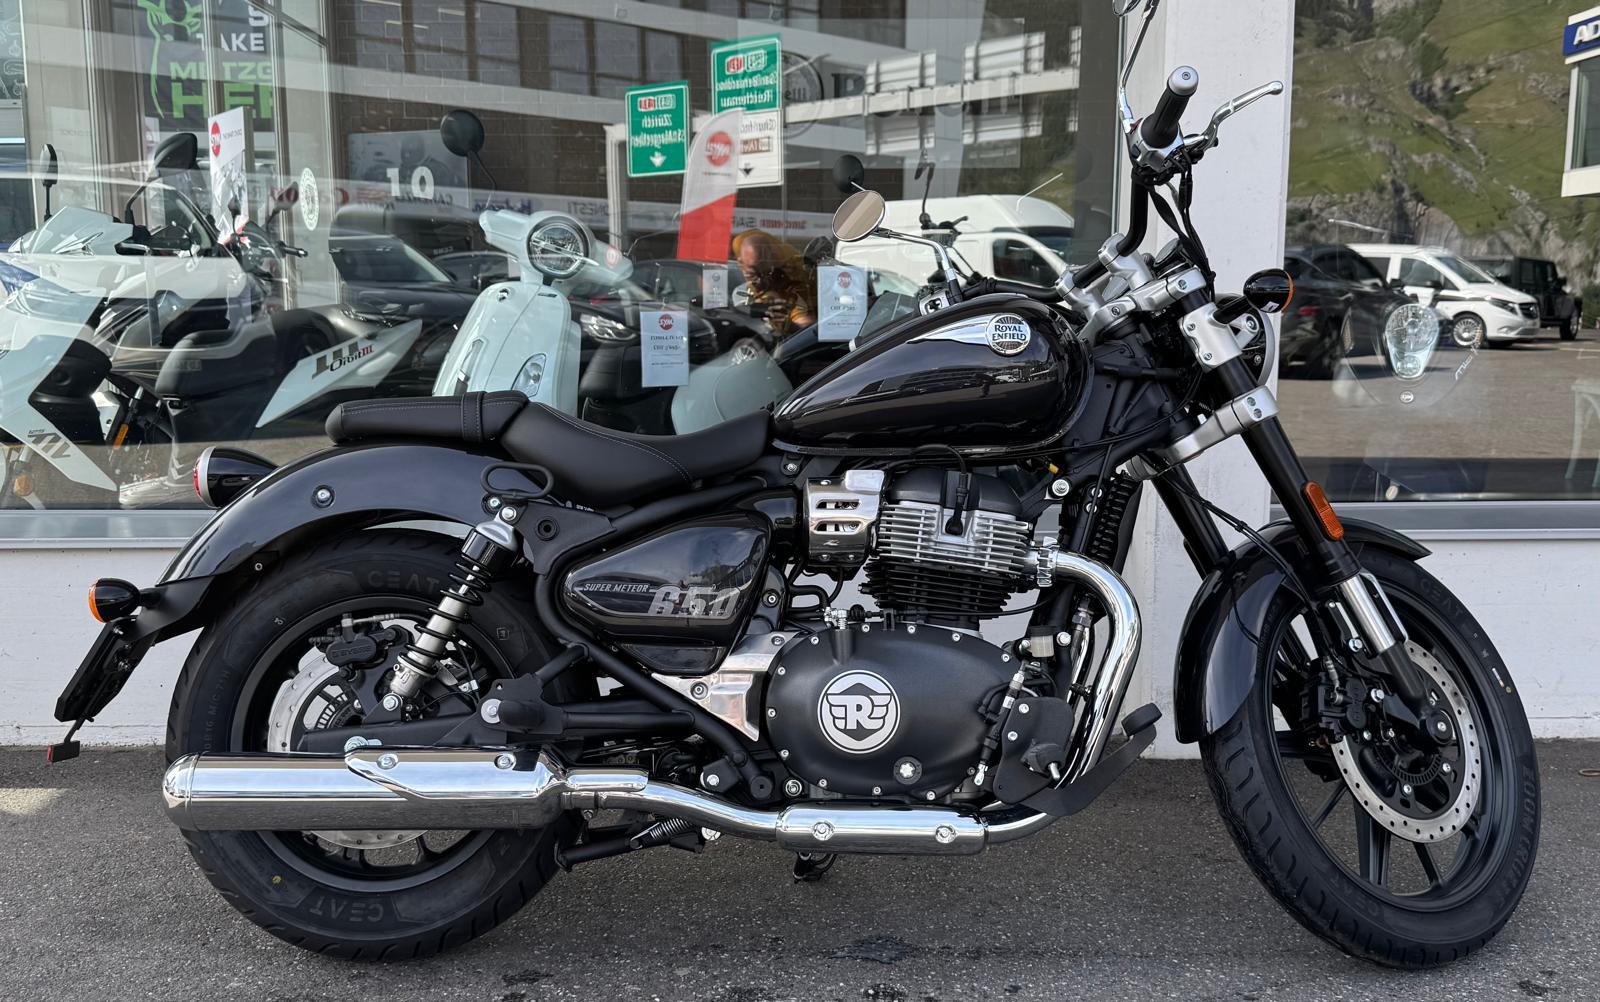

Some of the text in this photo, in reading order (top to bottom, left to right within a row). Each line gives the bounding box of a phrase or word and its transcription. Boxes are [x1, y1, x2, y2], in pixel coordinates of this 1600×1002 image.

[992, 333, 1027, 341] ENFIELD
[994, 324, 1023, 333] ROYAL
[367, 571, 439, 593] CEAT
[584, 583, 741, 618] SUPER METEOR 650
[309, 896, 384, 922] CEAT
